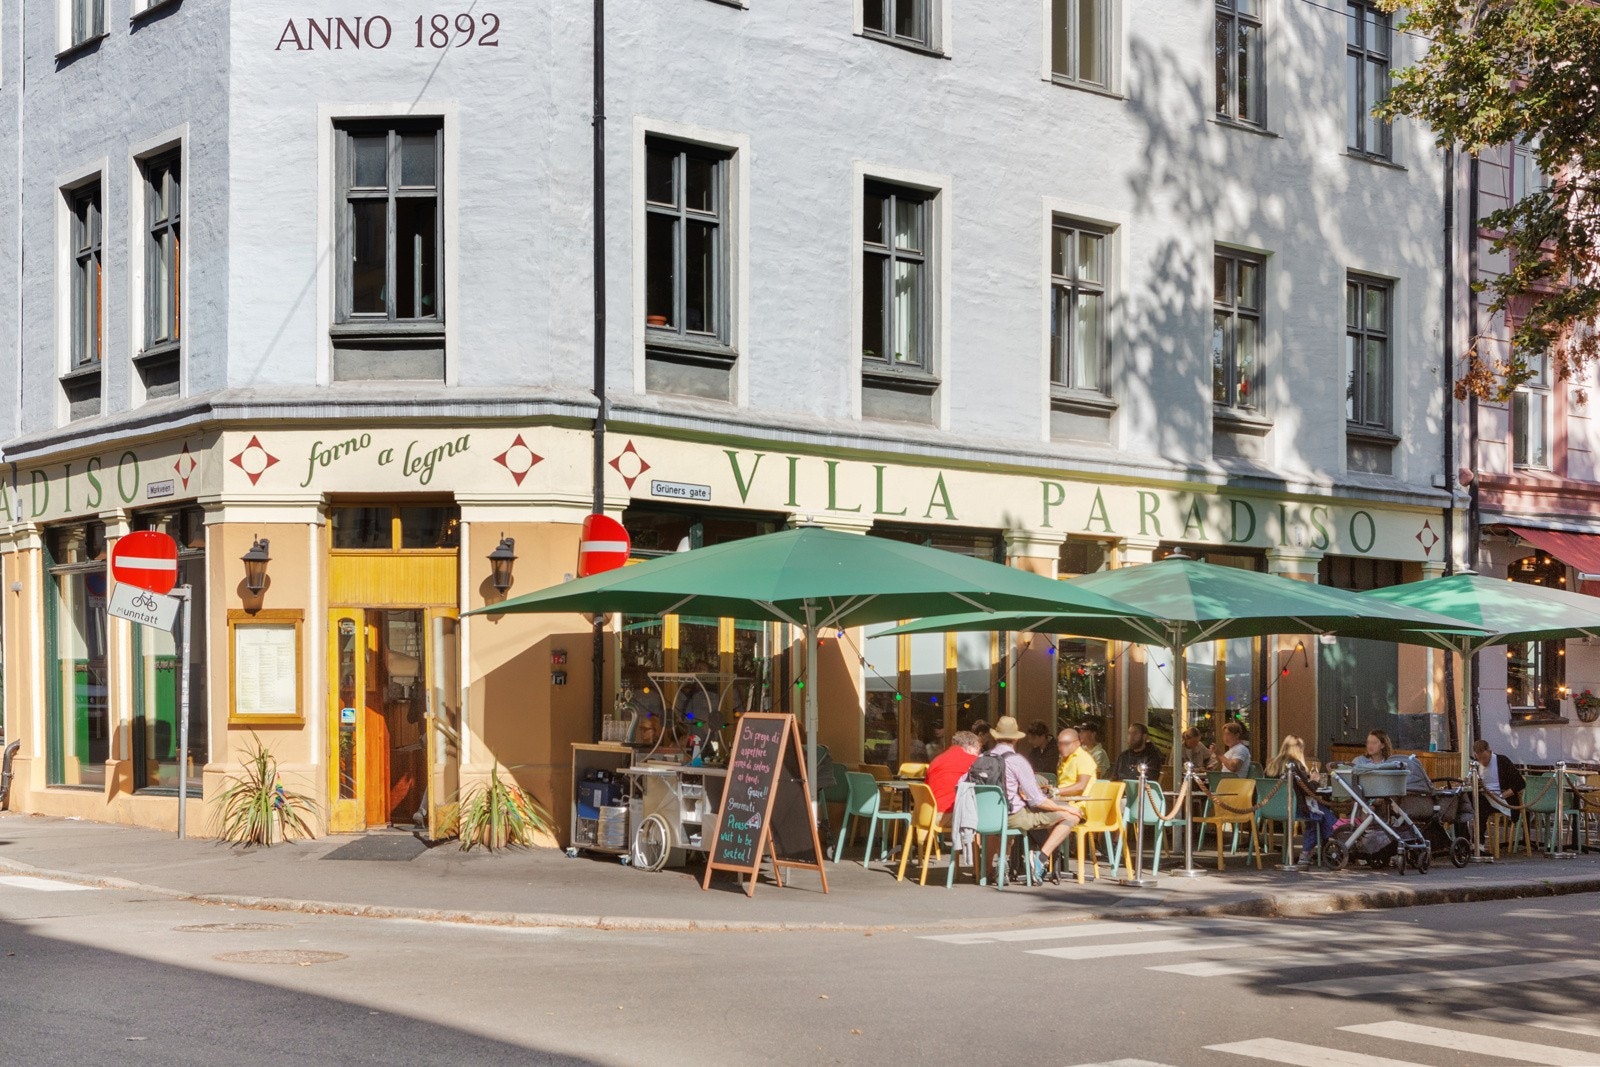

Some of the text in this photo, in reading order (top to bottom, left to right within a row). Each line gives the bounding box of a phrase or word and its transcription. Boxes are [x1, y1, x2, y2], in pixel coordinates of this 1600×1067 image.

[275, 12, 501, 51] ANNO 1892
[300, 433, 471, 488] forno a legna
[656, 484, 706, 497] Grüners gate
[723, 449, 1377, 554] VILLA PARADISO
[743, 727, 753, 741] Si
[771, 731, 780, 744] di
[728, 814, 749, 830] Please
[721, 832, 753, 846] wait to be
